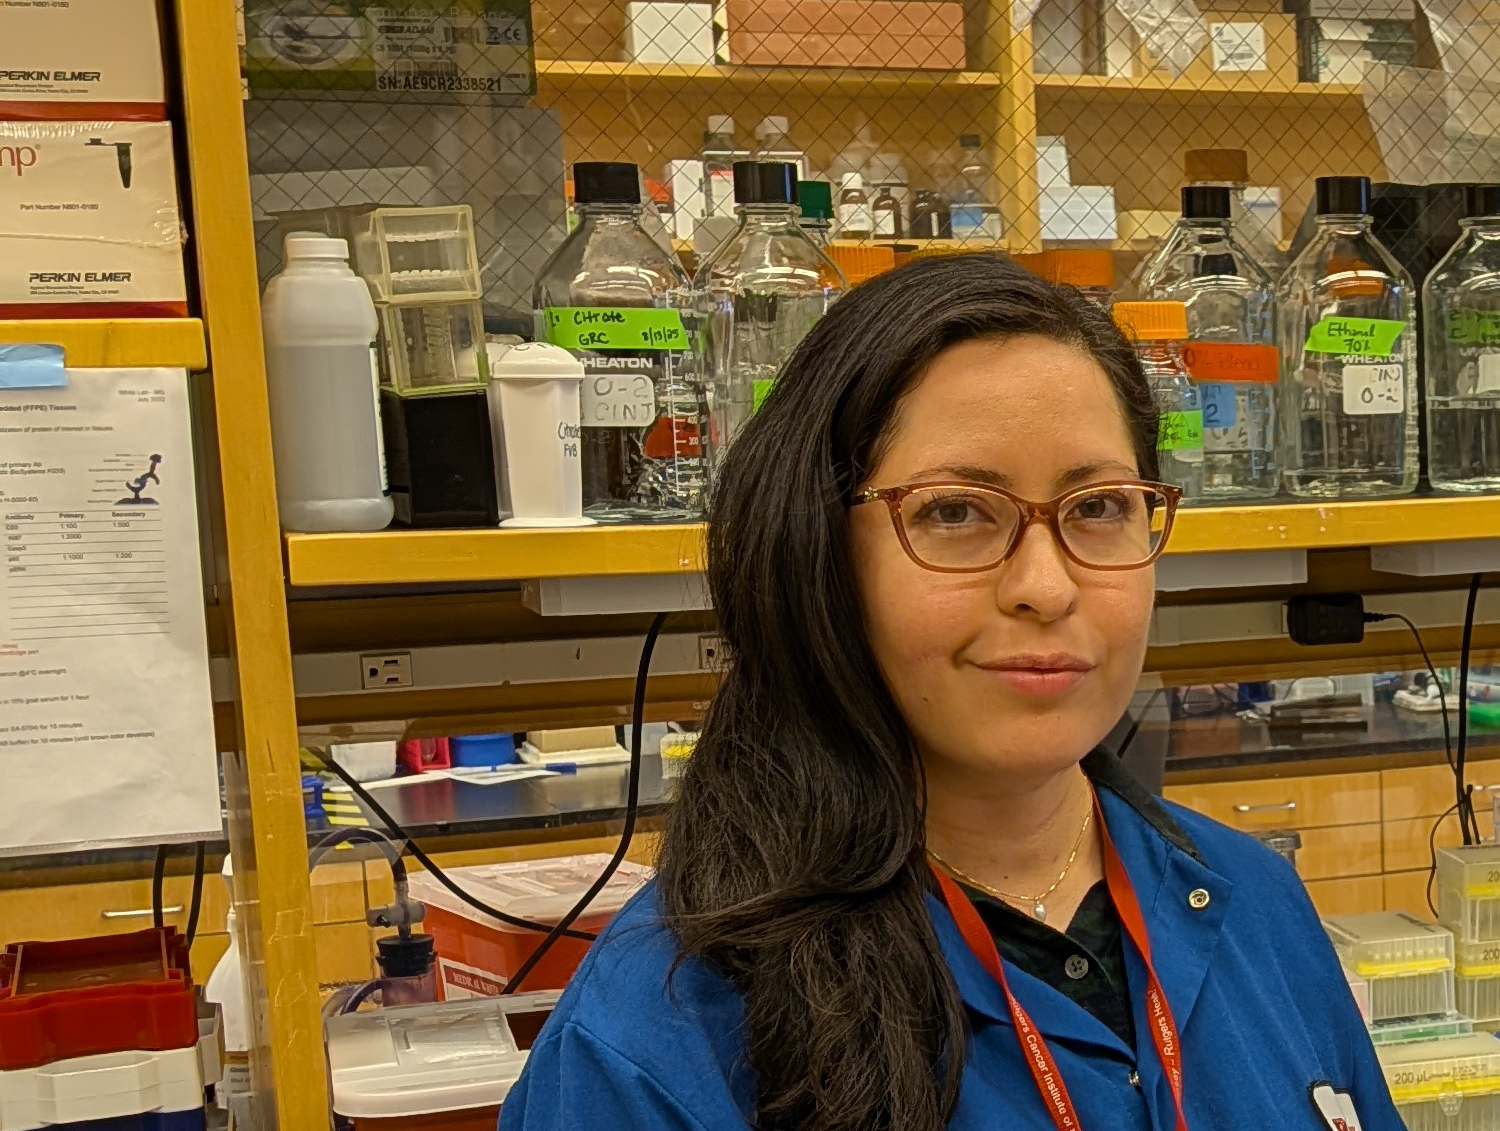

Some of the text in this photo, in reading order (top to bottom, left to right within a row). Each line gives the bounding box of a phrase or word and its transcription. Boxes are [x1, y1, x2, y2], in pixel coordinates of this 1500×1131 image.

[0, 71, 101, 82] PERKIN ELMER
[29, 272, 131, 283] PERKIN ELMER
[574, 311, 625, 325] Citrate
[1482, 949, 1500, 961] 200
[1026, 1034, 1049, 1072] Cancer
[1044, 1073, 1067, 1115] Institute
[1394, 1071, 1414, 1085] 200
